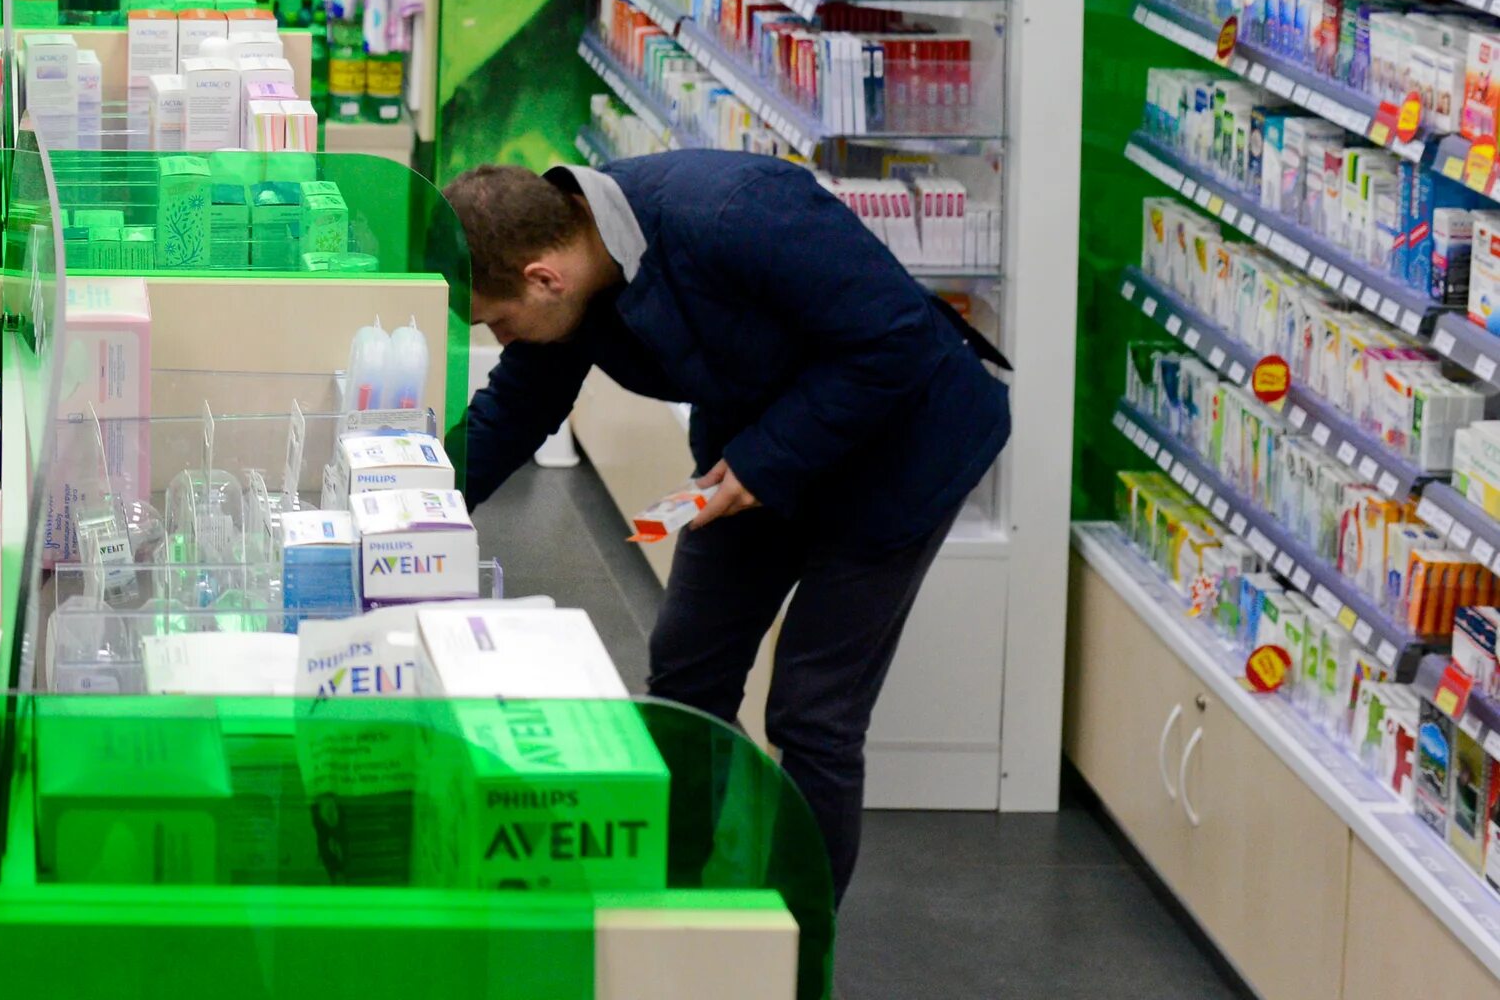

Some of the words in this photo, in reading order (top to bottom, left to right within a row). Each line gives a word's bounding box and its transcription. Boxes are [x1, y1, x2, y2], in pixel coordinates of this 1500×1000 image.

[160, 99, 182, 107] LACTA
[357, 475, 397, 483] PHILIPS
[369, 541, 414, 551] PHILIPS
[370, 554, 447, 575] AVENT
[487, 789, 580, 809] PHILIPS
[484, 821, 649, 860] AVENT
